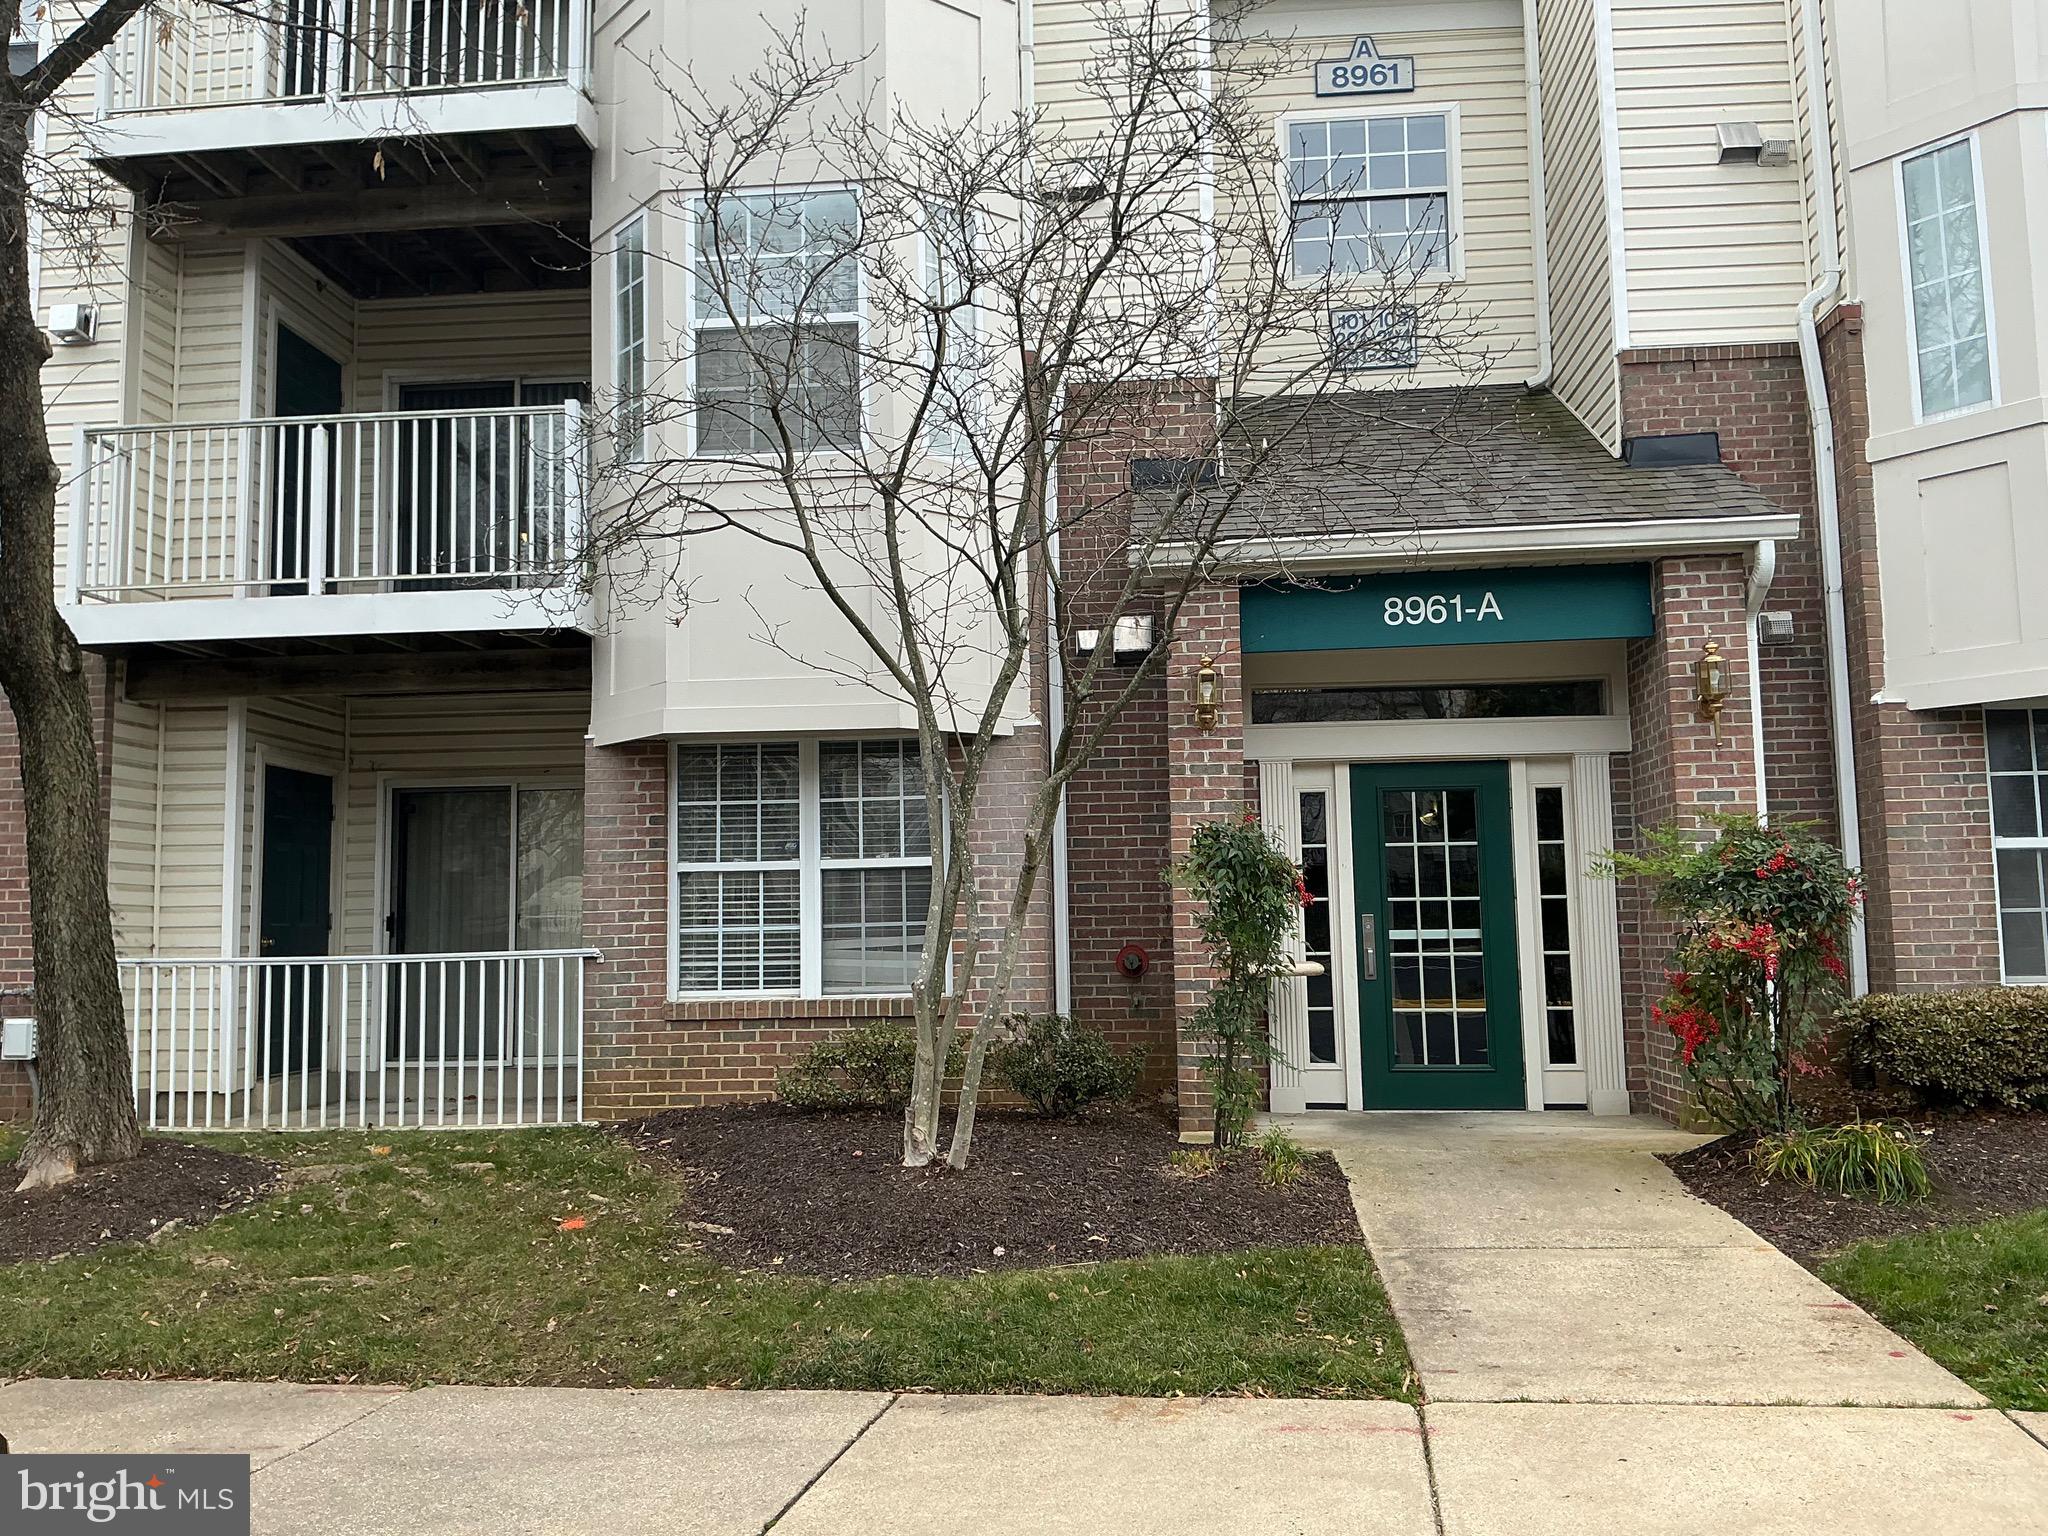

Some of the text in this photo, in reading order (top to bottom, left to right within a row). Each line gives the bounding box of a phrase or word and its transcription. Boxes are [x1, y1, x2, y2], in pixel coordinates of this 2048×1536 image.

[1356, 40, 1373, 58] A
[1332, 63, 1399, 88] 8961
[1383, 591, 1504, 626] 8961-A
